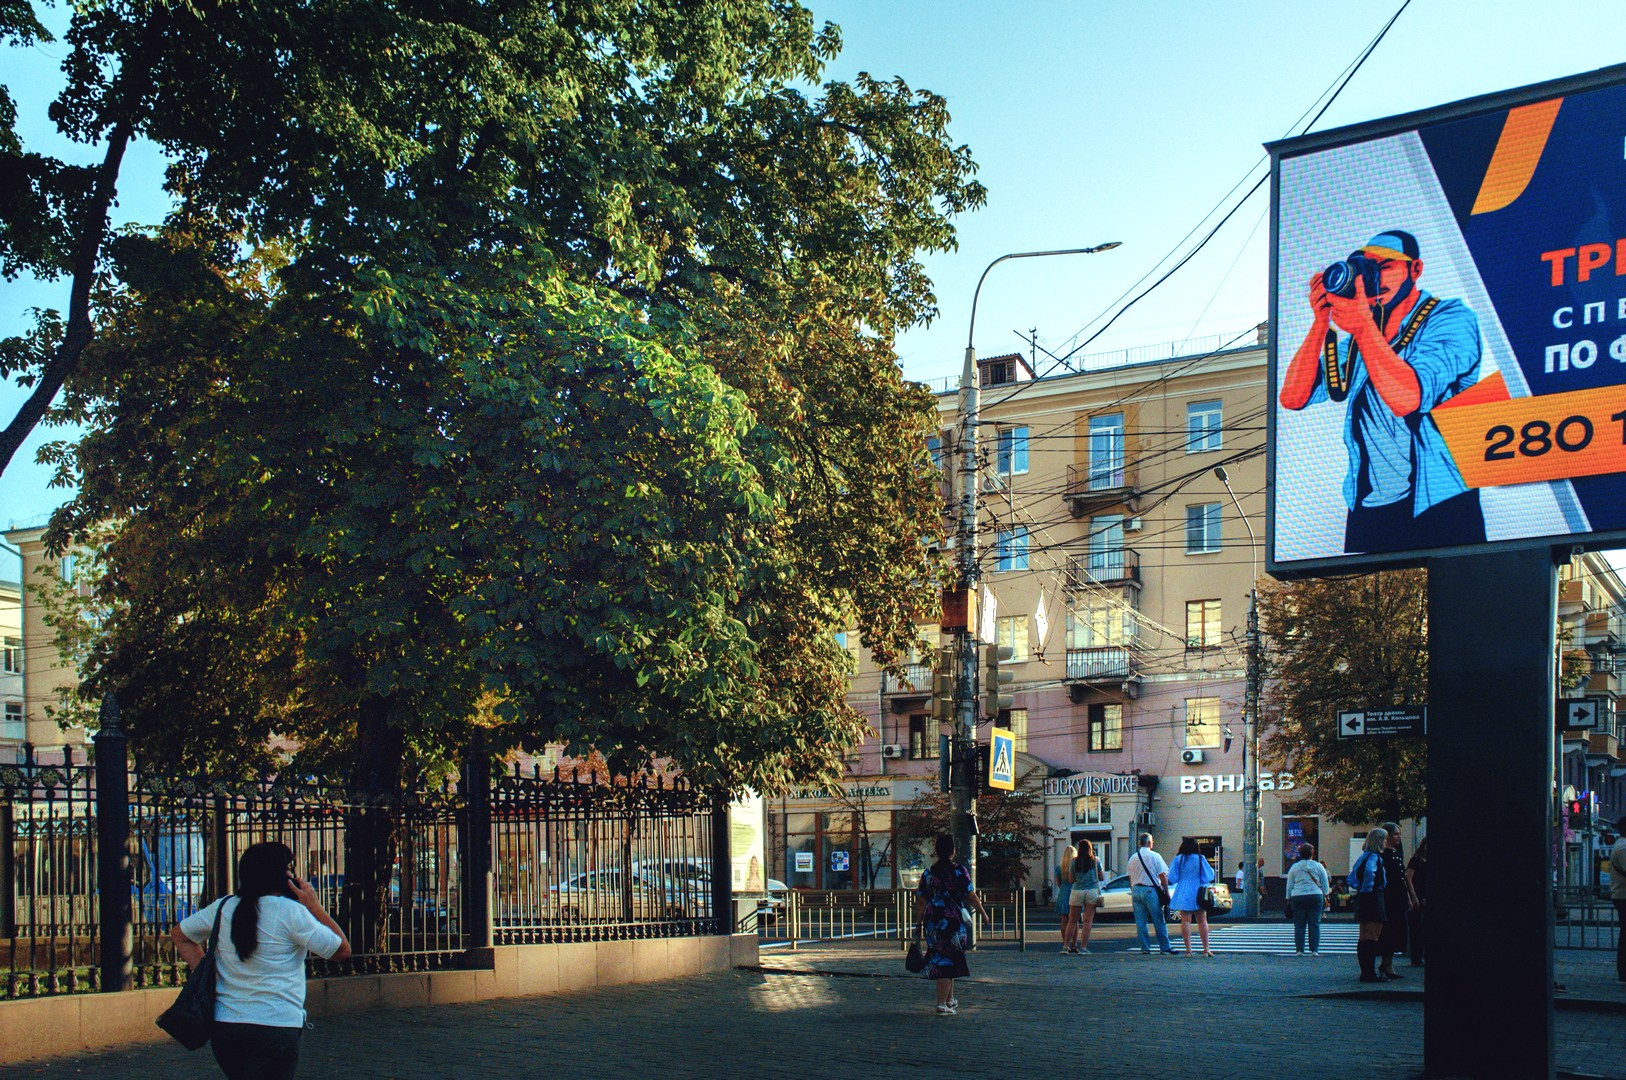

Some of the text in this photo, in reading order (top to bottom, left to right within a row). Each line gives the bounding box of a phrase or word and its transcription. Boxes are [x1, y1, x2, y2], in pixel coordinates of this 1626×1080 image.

[1544, 339, 1598, 374] ПО
[1484, 415, 1594, 462] 280
[1044, 775, 1137, 795] LUCKY SMOKE
